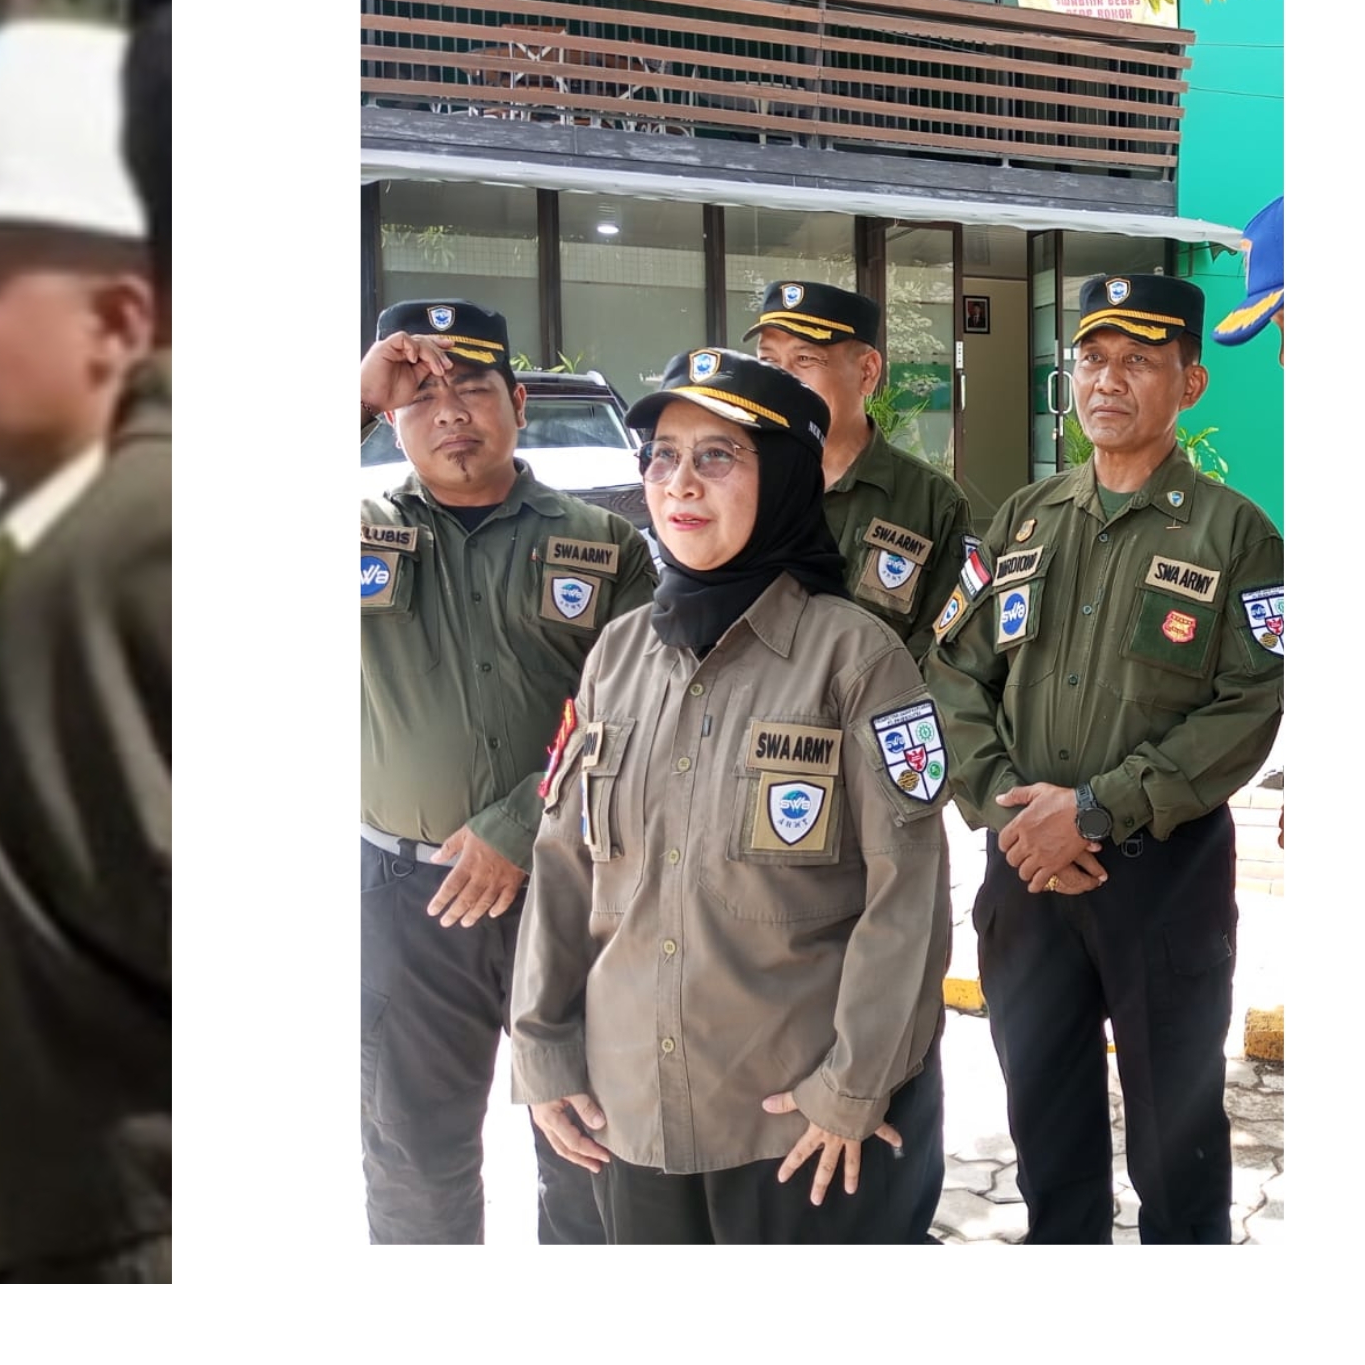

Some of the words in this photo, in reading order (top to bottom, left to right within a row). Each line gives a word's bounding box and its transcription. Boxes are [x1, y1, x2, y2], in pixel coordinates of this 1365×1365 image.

[553, 542, 580, 561] SWA
[579, 547, 613, 566] ARMY
[872, 525, 896, 543] SWA
[895, 534, 926, 556] ARMY
[1154, 562, 1178, 585] SWA
[1179, 568, 1215, 595] ARMY
[755, 732, 790, 760] SWA
[791, 736, 834, 764] ARMY
